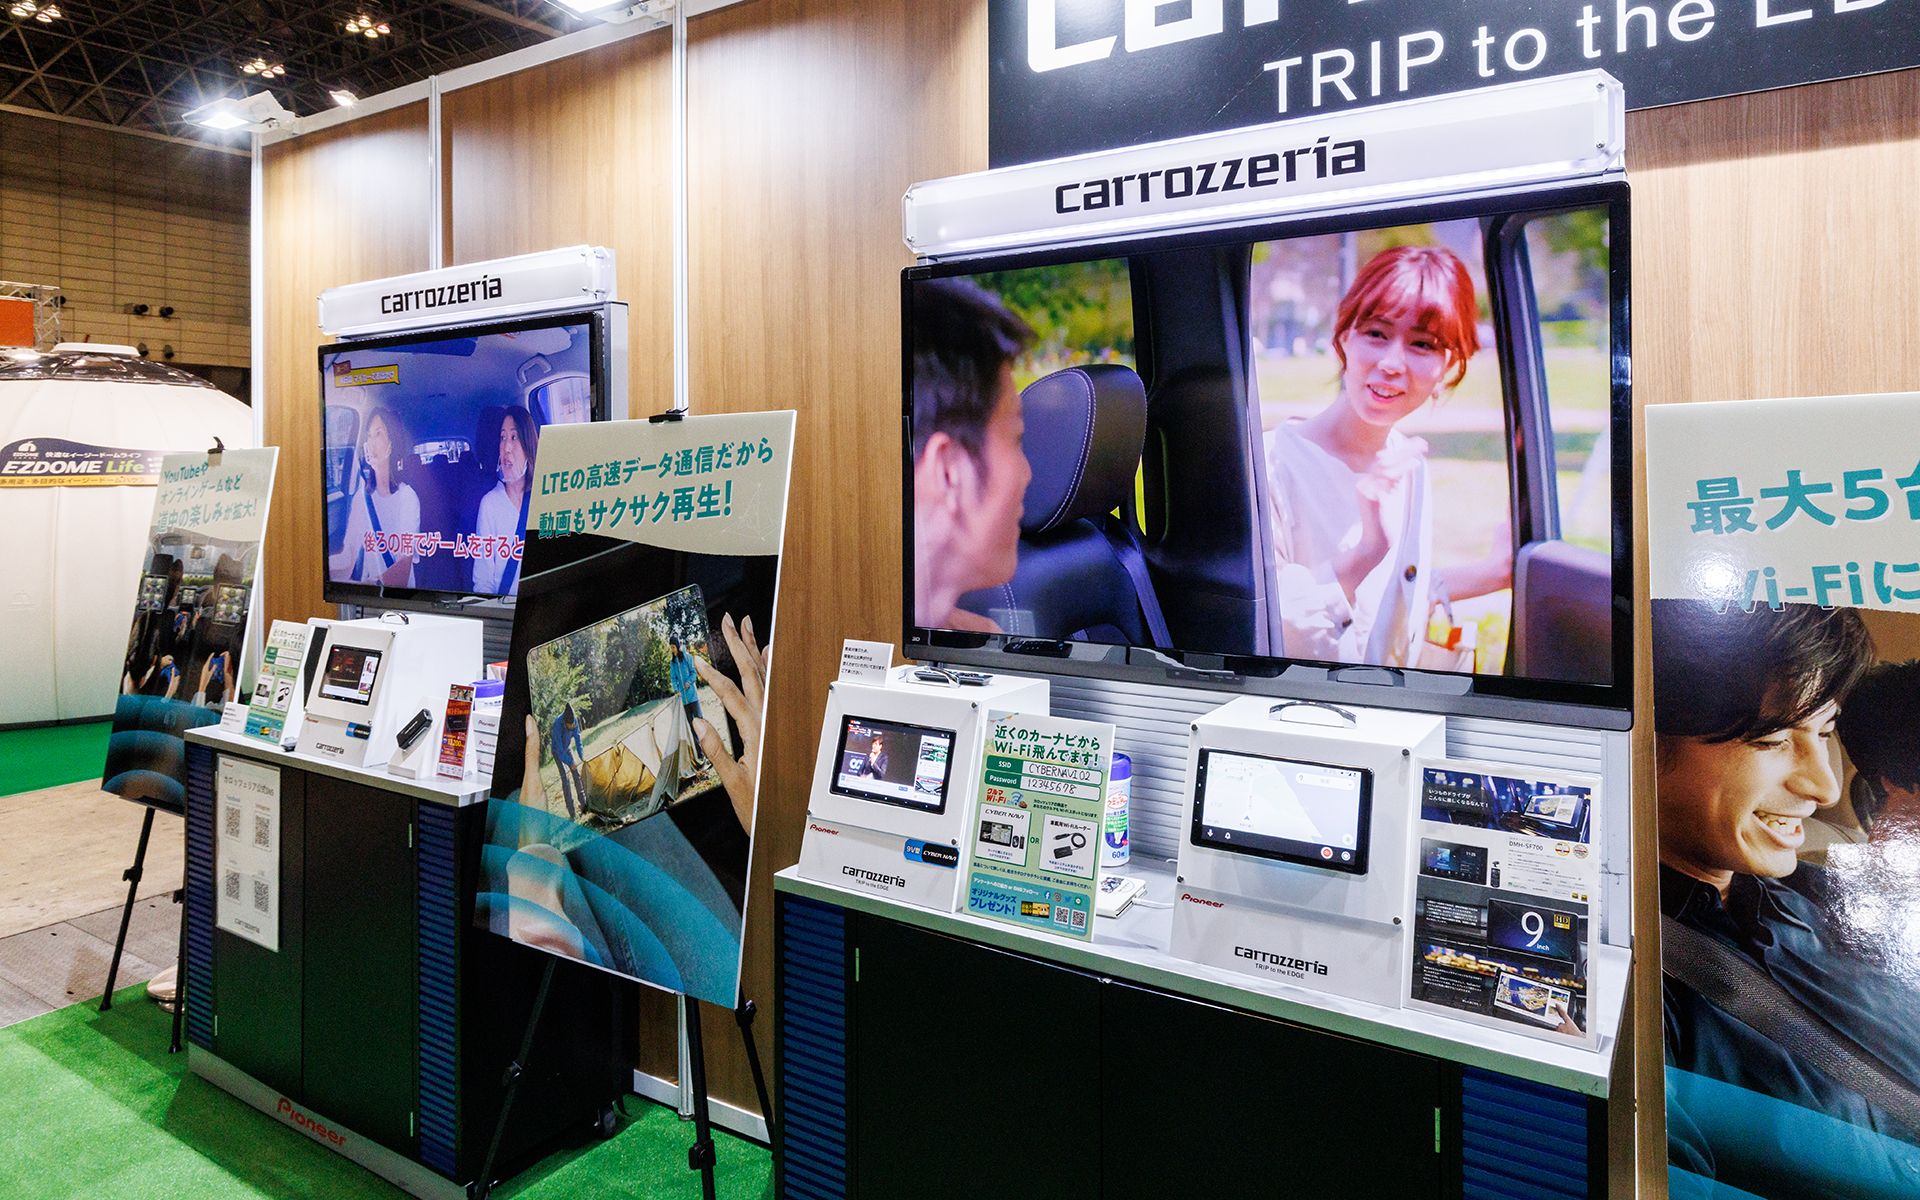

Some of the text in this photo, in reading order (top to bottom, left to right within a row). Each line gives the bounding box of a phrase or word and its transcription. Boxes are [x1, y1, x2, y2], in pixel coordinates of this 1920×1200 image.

[1264, 30, 1444, 113] TRIP
[1472, 26, 1547, 77] to
[1576, 0, 1715, 59] the
[1055, 136, 1366, 214] carrozzeria
[381, 275, 502, 314] carrozzeria
[1, 460, 104, 474] EZDOME
[105, 459, 145, 473] Life
[541, 437, 774, 495] LTEの高速データ通信だから
[537, 480, 732, 539] 動画もサクサク再生!
[363, 531, 525, 559] 後ろの席でゲームをすると
[994, 725, 1101, 751] 近くのカーナビから
[994, 740, 1099, 767] Wi-Fi飛んでます!
[998, 760, 1012, 769] SSID
[1028, 763, 1091, 782] CYBERNAVI 02
[989, 774, 1017, 785] Password
[1027, 778, 1077, 795] 12345678
[986, 788, 1004, 796] クルマ
[1428, 789, 1471, 799] いつものドライブが
[985, 808, 1007, 817] CYBER
[809, 823, 839, 836] Pioneer
[923, 850, 943, 858] CYBER
[1508, 840, 1543, 851] DMH-SF700
[842, 865, 906, 888] carrozzeria
[971, 888, 1017, 903] オリジナルグッズ
[1181, 893, 1224, 908] Pioneer
[970, 897, 1016, 916] プレゼント!
[1521, 911, 1550, 951] 9 inch
[1234, 945, 1328, 976] carrozzeria
[1255, 963, 1269, 971] TRIP
[1287, 970, 1305, 980] EDGE
[276, 1097, 347, 1147] Pioneer
